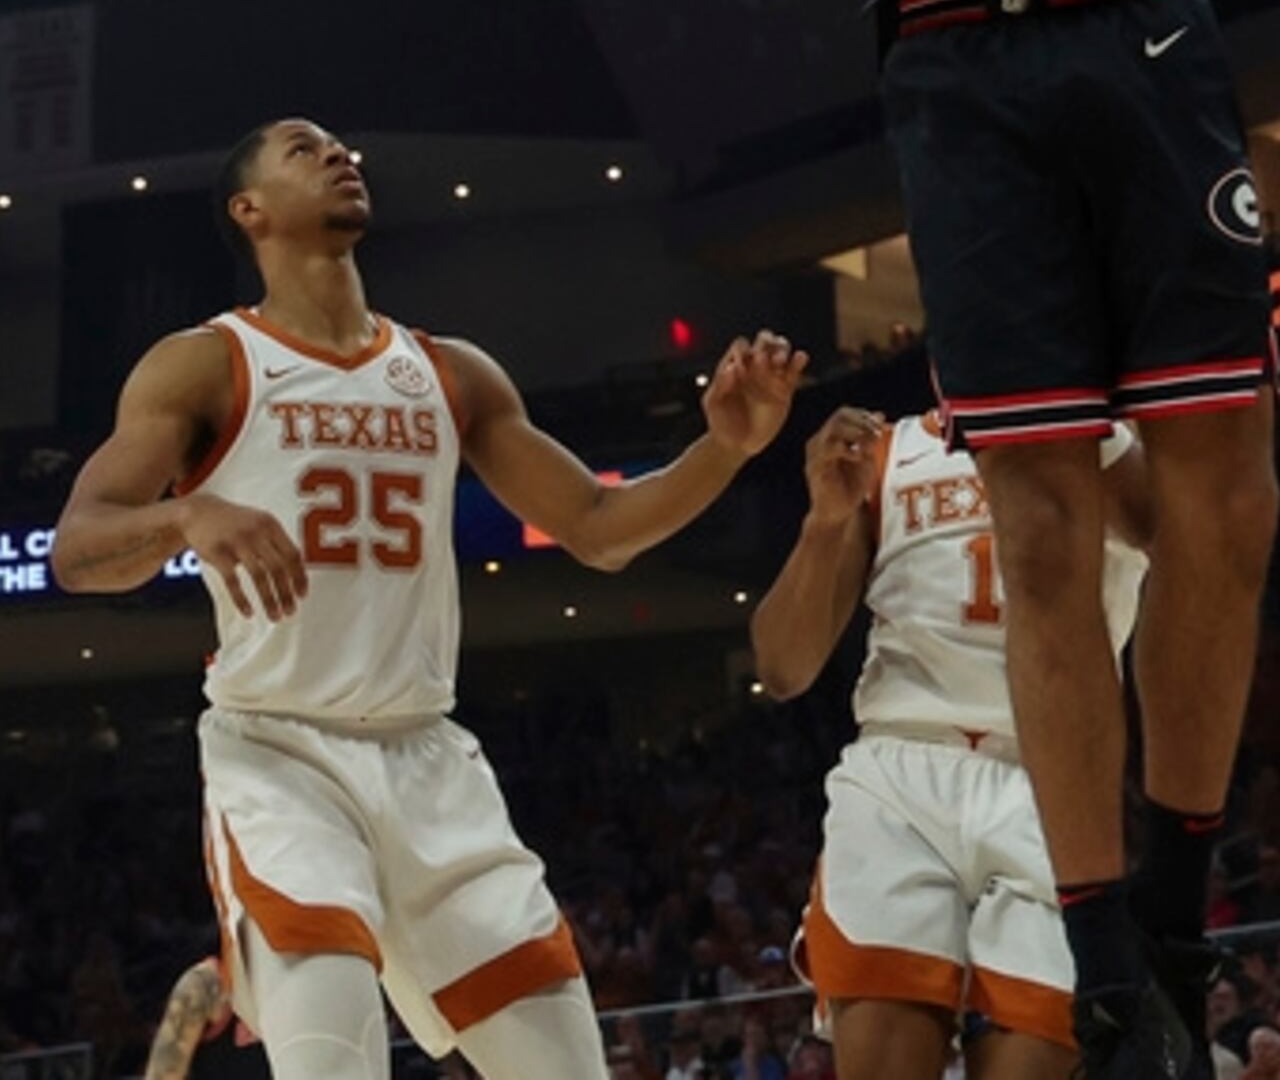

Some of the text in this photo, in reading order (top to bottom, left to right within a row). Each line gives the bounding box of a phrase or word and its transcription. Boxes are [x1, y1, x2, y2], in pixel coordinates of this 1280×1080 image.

[270, 401, 440, 458] TEXAS
[296, 466, 424, 574] 25
[895, 474, 992, 536] TEX
[961, 531, 1004, 626] 1
